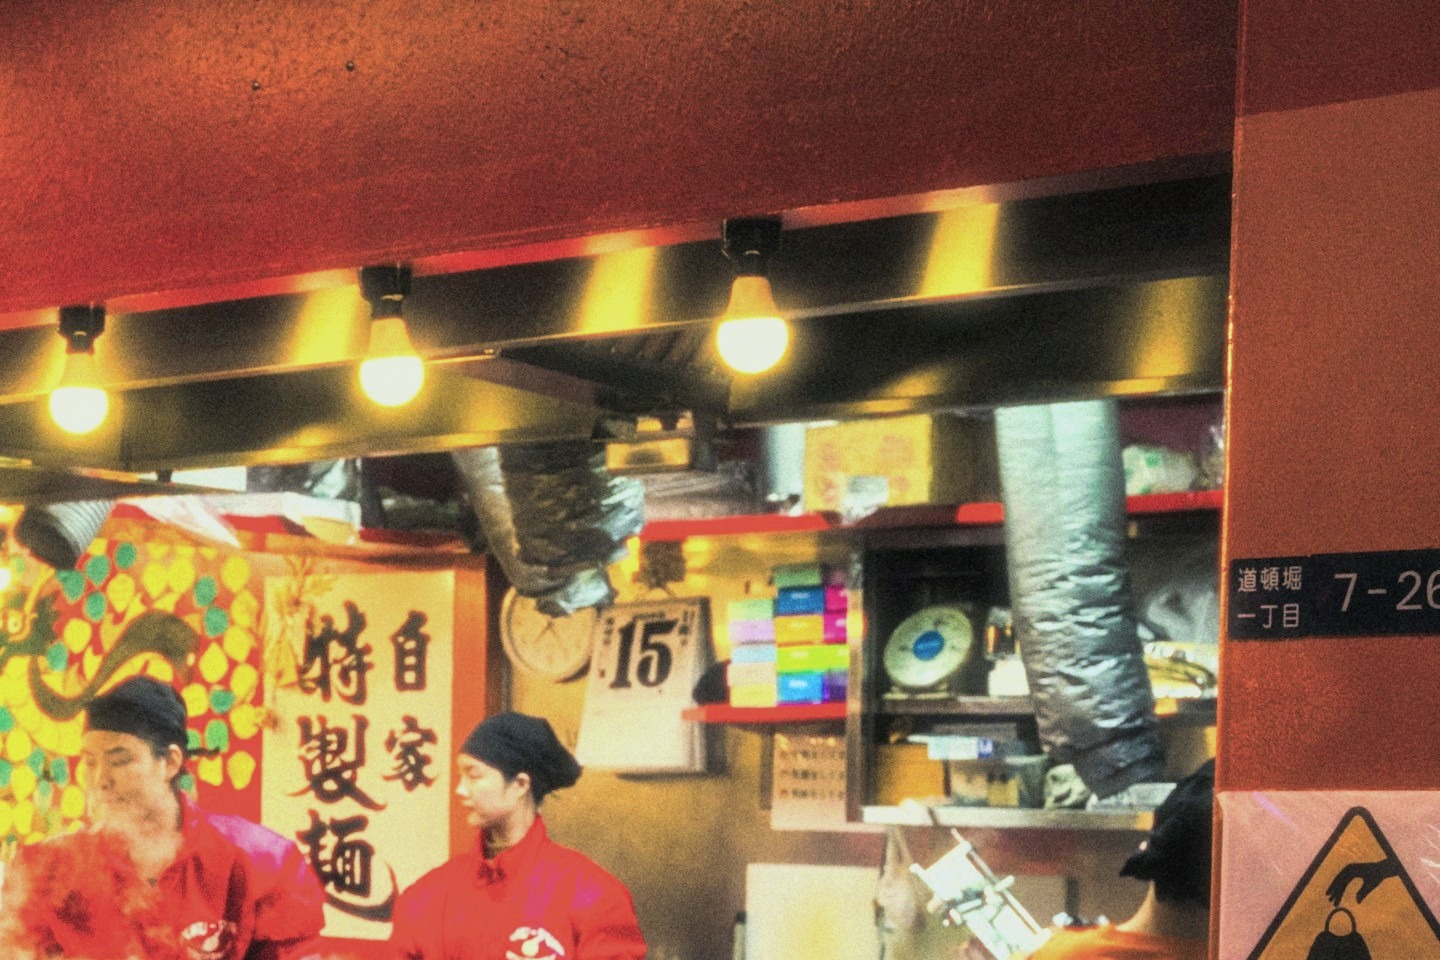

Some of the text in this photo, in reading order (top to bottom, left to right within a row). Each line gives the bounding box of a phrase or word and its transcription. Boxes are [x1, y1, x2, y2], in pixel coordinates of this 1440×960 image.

[1237, 566, 1302, 592] 道頓堀
[1334, 570, 1440, 612] 7-26
[1237, 603, 1300, 629] 一丁目
[610, 618, 679, 689] 15
[383, 610, 438, 792] 自家
